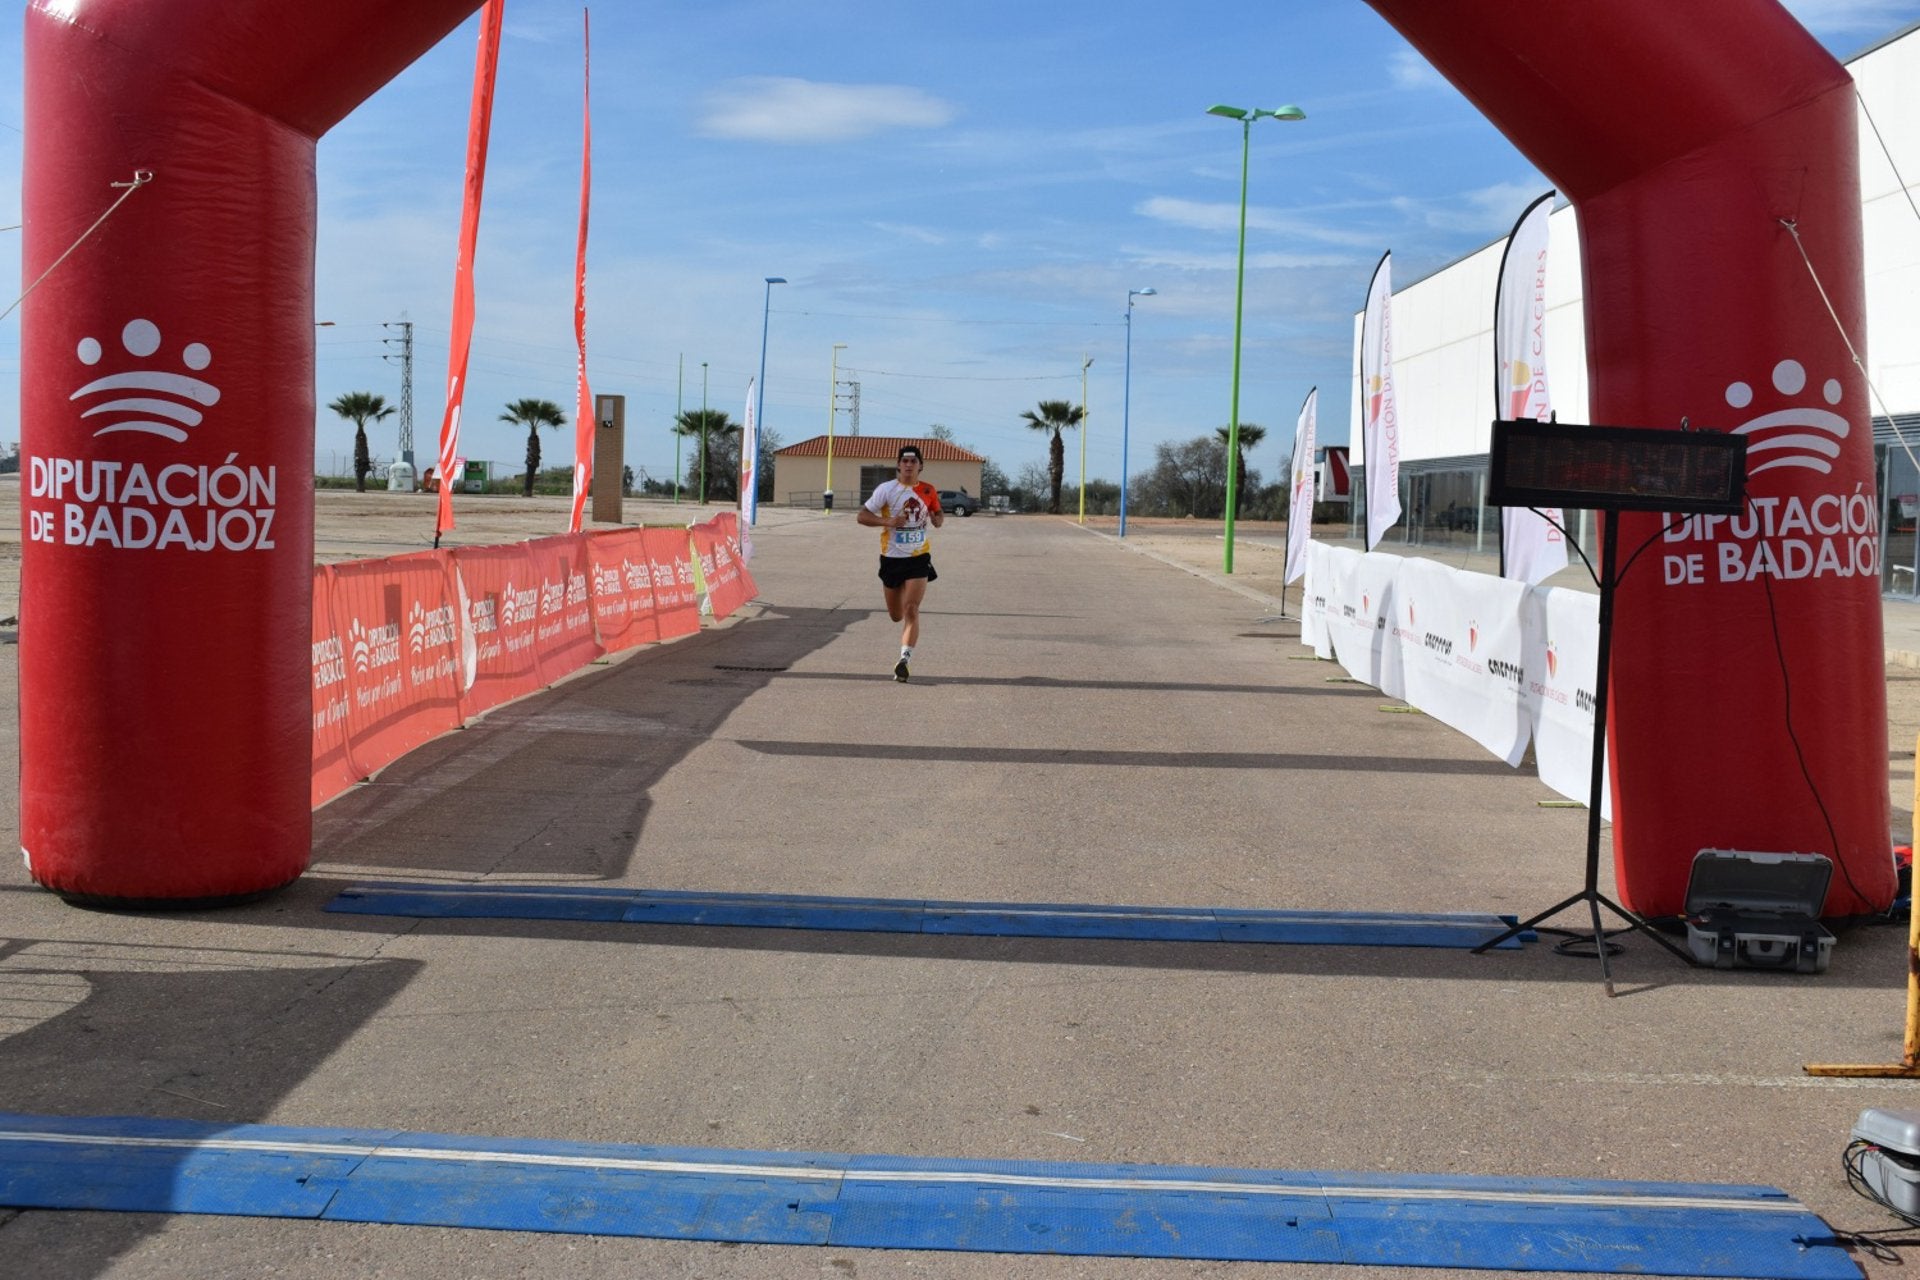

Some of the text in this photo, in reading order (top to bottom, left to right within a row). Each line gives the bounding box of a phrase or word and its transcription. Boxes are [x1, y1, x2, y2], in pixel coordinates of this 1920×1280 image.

[1533, 366, 1546, 394] DE
[31, 452, 276, 507] DIPUTACIÓN
[31, 503, 275, 551] DE BADAJOZ
[1662, 482, 1877, 543] DIPUTACIÓN
[900, 531, 922, 543] 159
[1664, 536, 1880, 585] DE BADAJOZ
